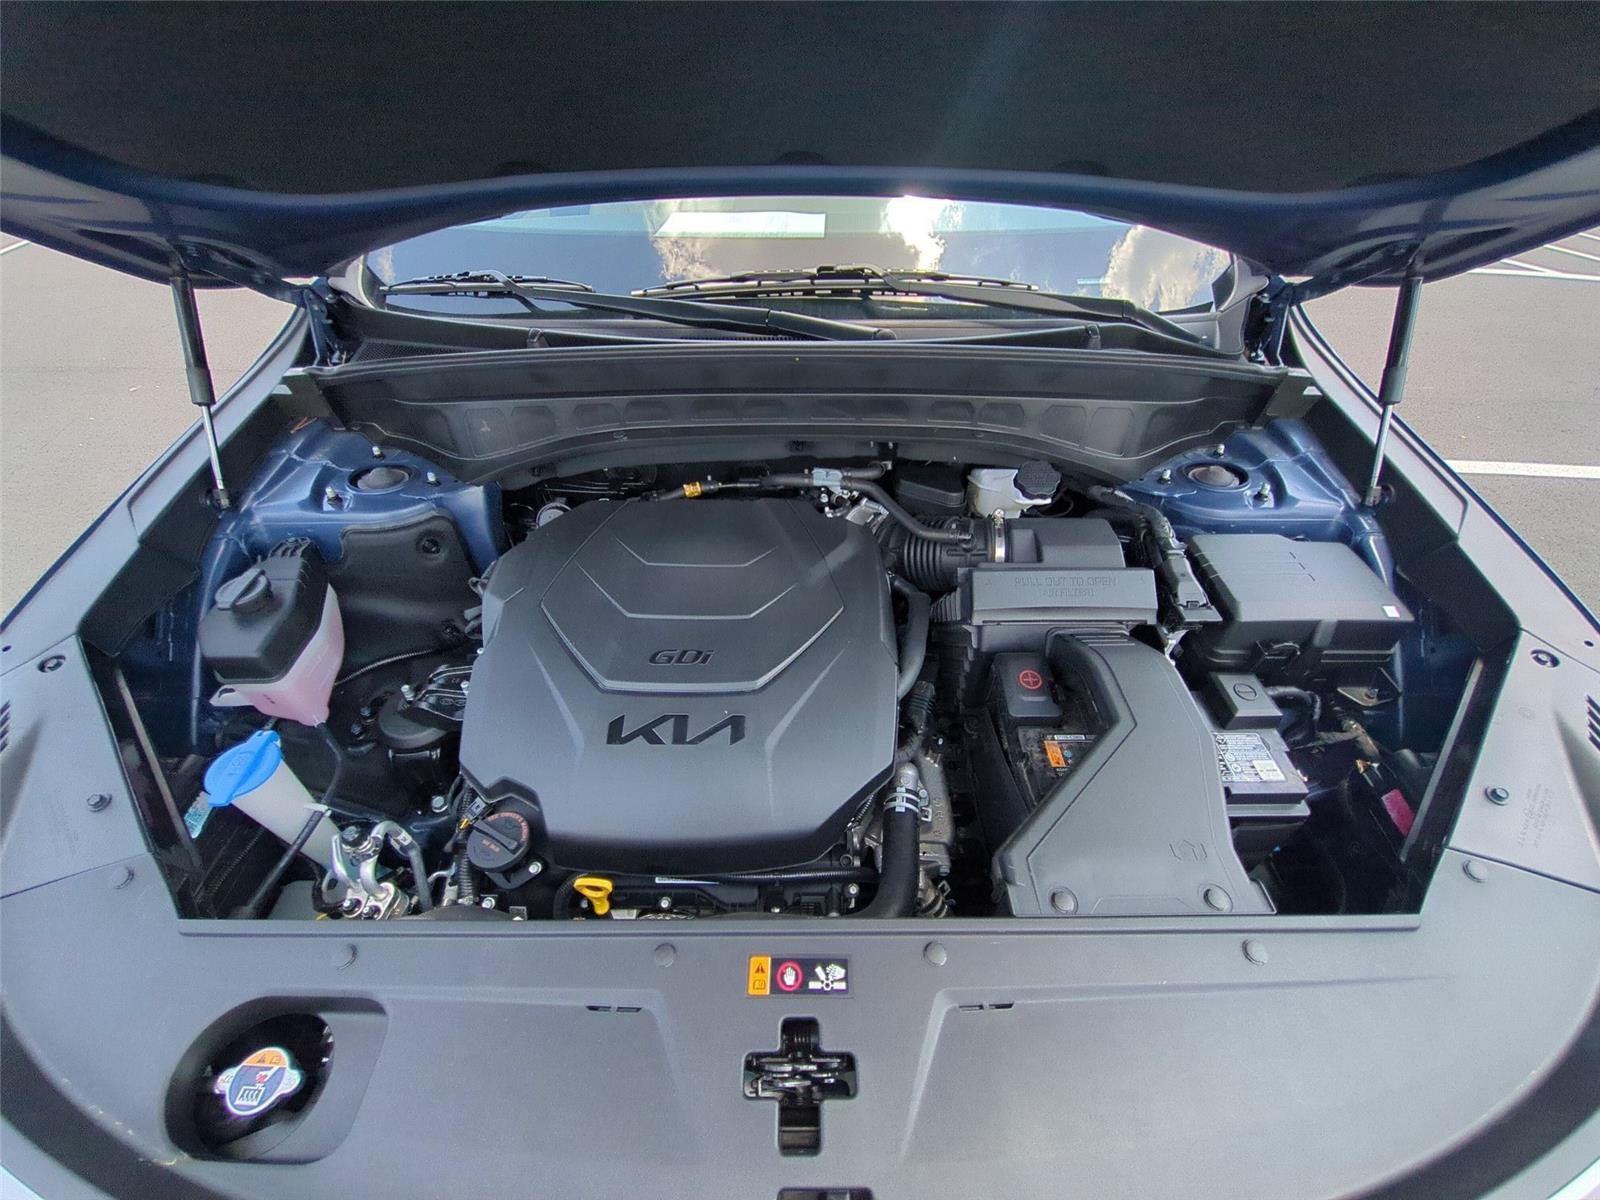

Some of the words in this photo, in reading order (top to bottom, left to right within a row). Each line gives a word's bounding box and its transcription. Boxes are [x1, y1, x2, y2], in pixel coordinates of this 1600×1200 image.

[1014, 576, 1042, 587] PULL
[1045, 576, 1066, 587] OUT
[1069, 576, 1084, 587] TO
[1087, 576, 1117, 587] OPEN
[649, 650, 715, 666] GDi
[606, 713, 746, 746] KIA
